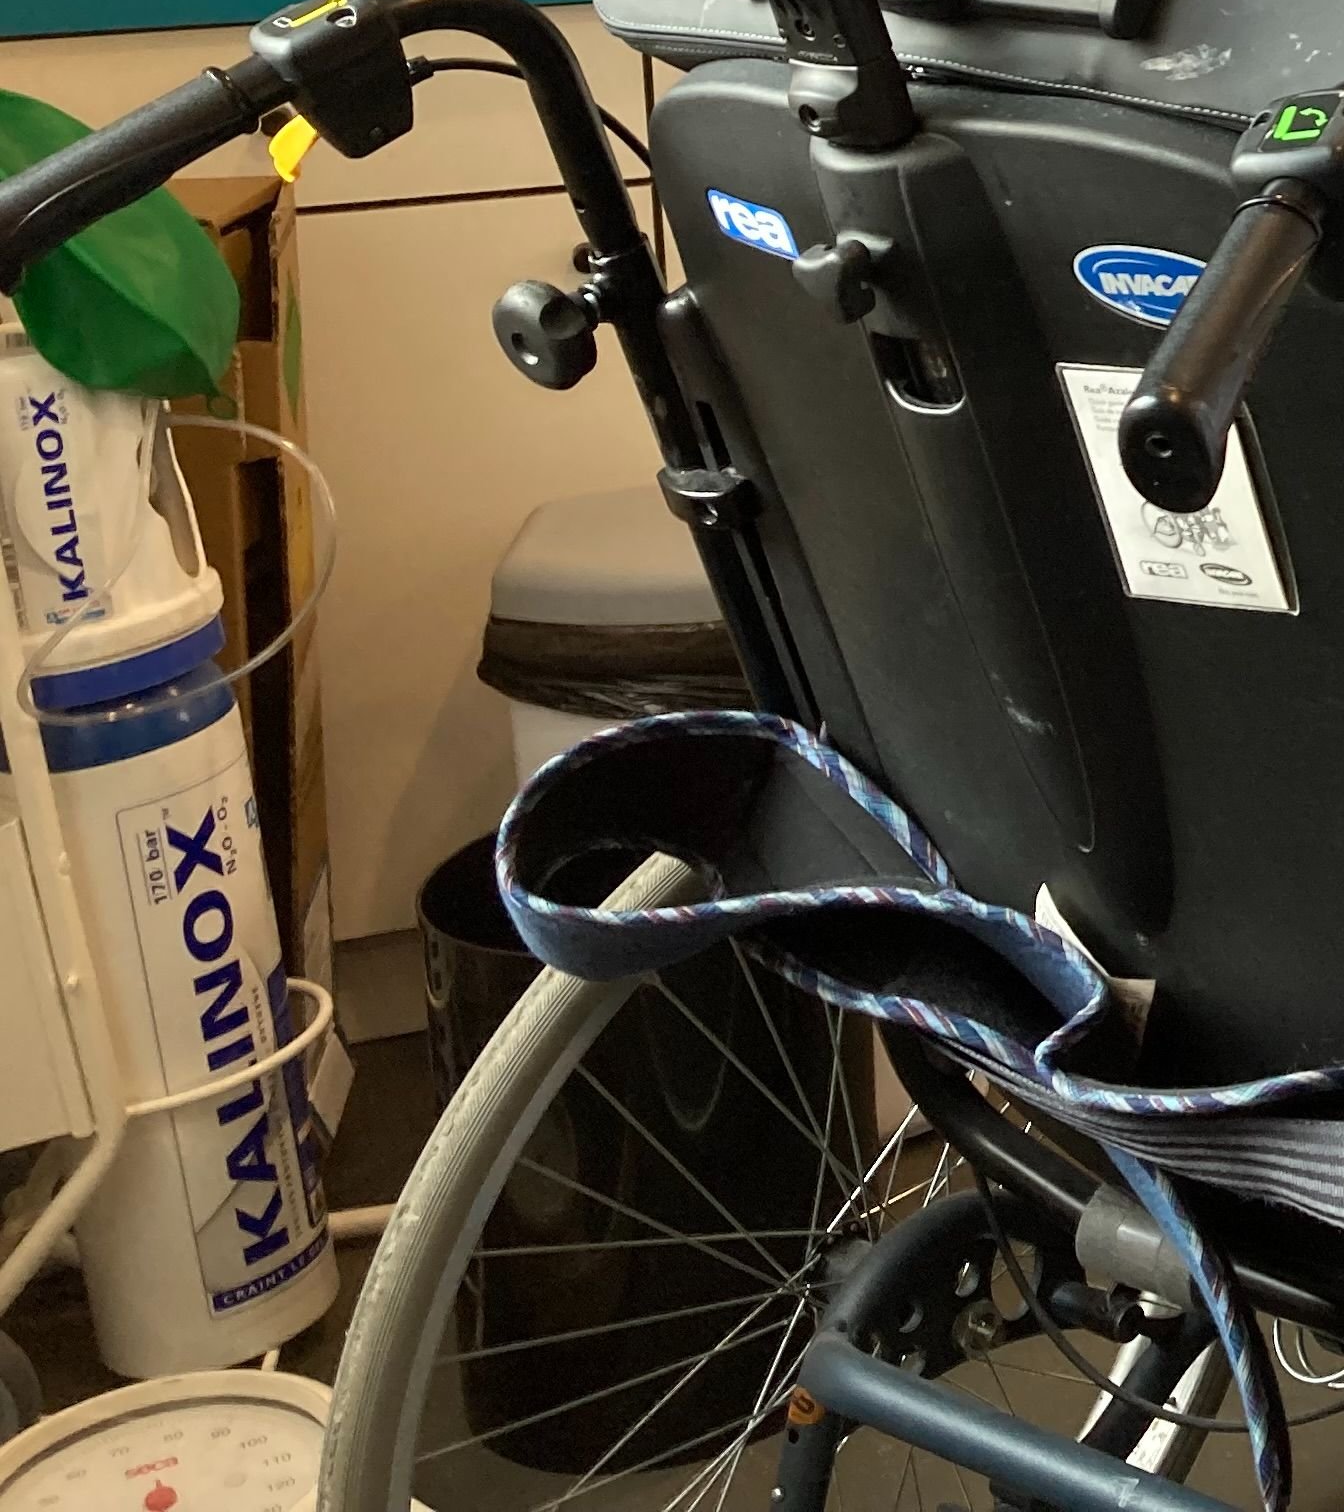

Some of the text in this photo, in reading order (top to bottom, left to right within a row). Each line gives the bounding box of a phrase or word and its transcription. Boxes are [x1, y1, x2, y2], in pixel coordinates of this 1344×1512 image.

[711, 195, 794, 253] rea
[29, 392, 89, 602] KALINOX
[144, 829, 168, 905] 170 bar
[165, 804, 290, 1266] KALINOX
[239, 1435, 268, 1449] 100
[263, 1453, 292, 1467] 110
